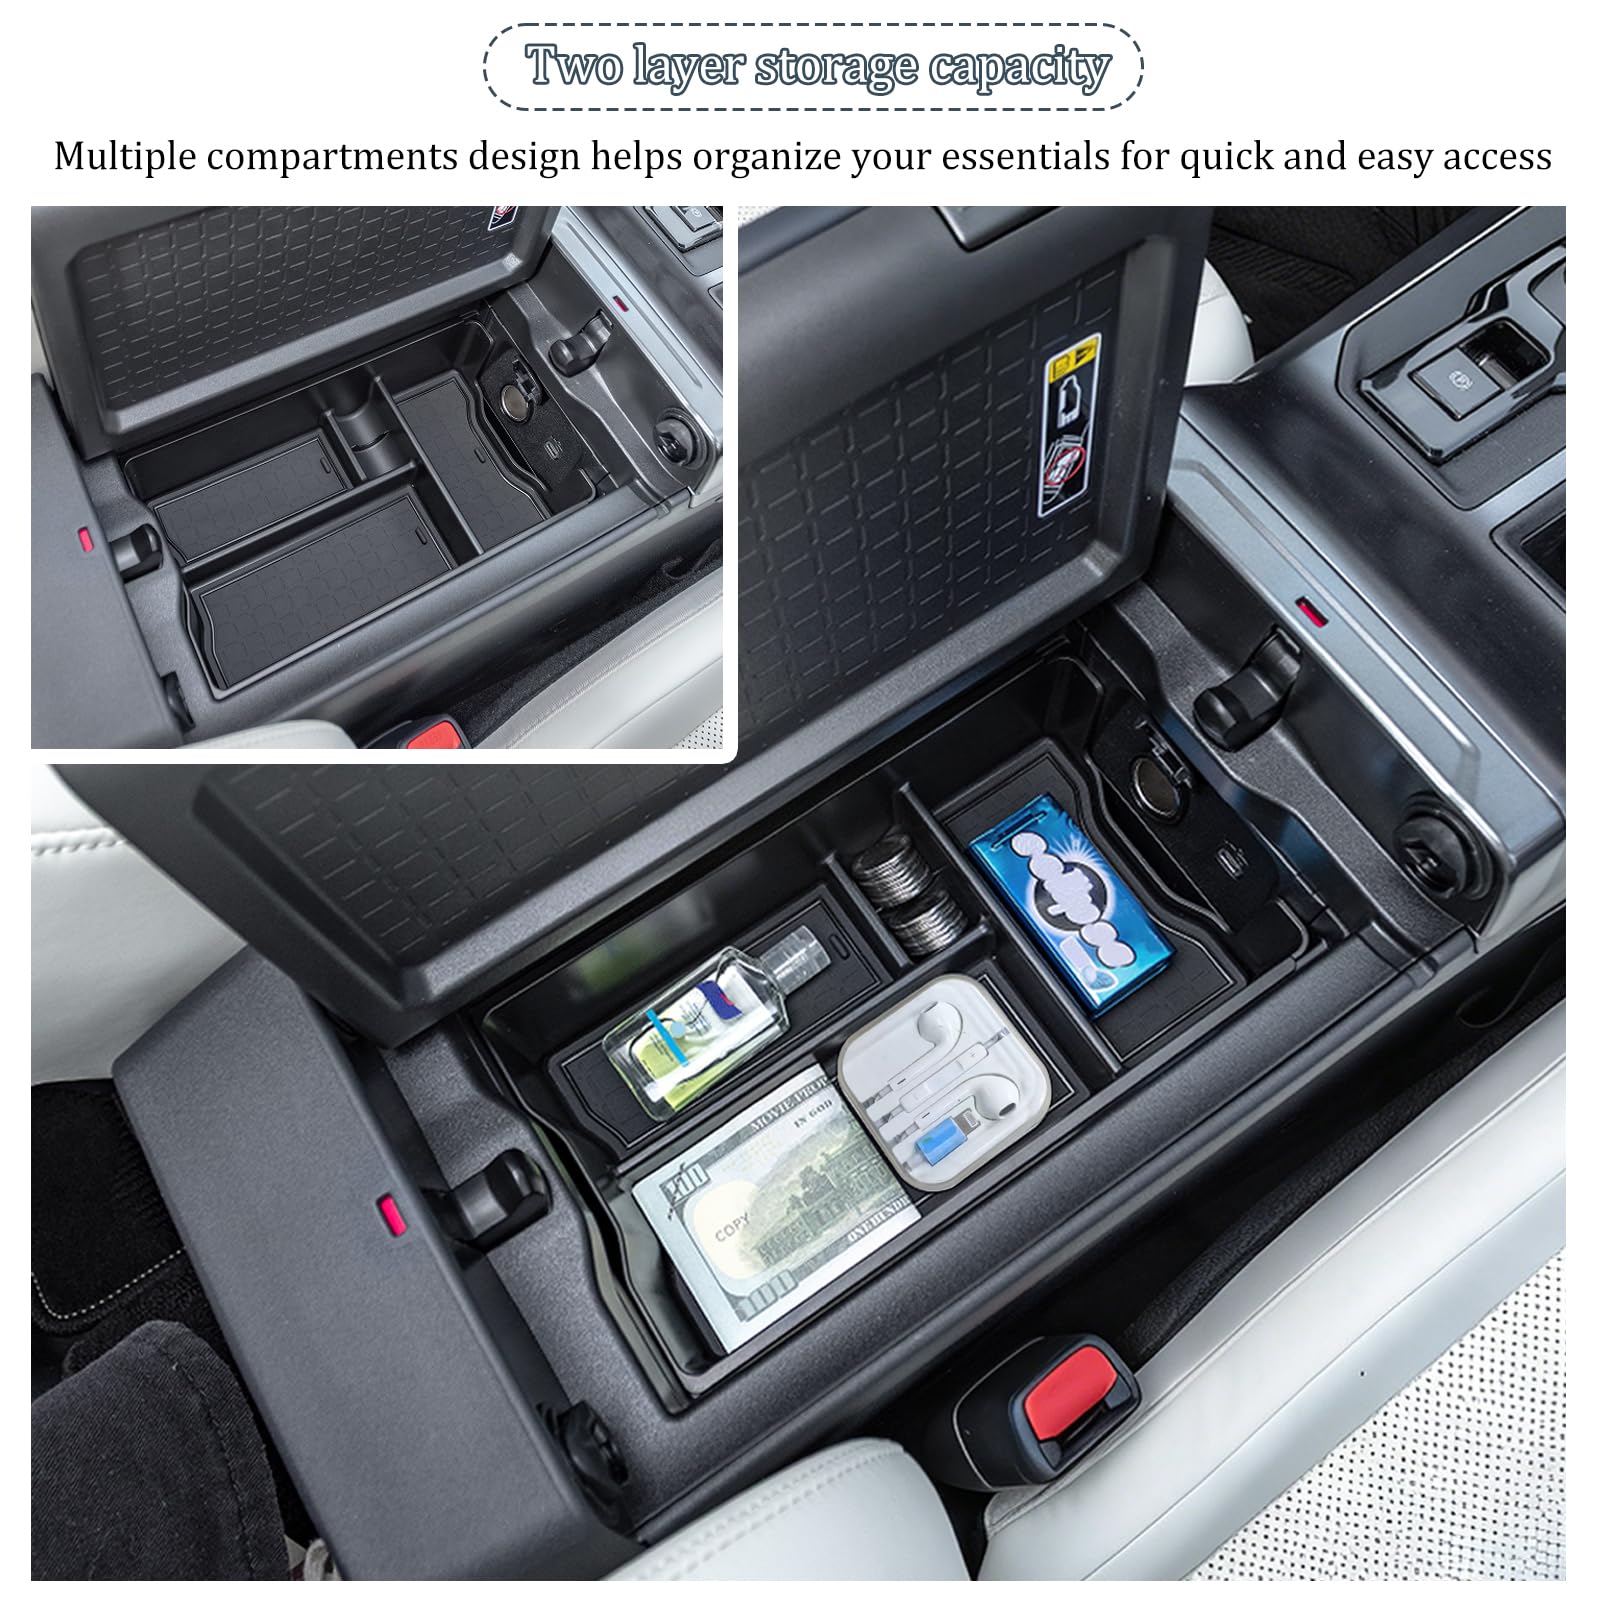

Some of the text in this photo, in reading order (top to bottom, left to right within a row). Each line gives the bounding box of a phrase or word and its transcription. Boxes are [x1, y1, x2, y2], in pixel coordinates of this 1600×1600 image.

[751, 1097, 795, 1132] MOVIE
[808, 1099, 833, 1118] GOD
[715, 1211, 750, 1242] COPY
